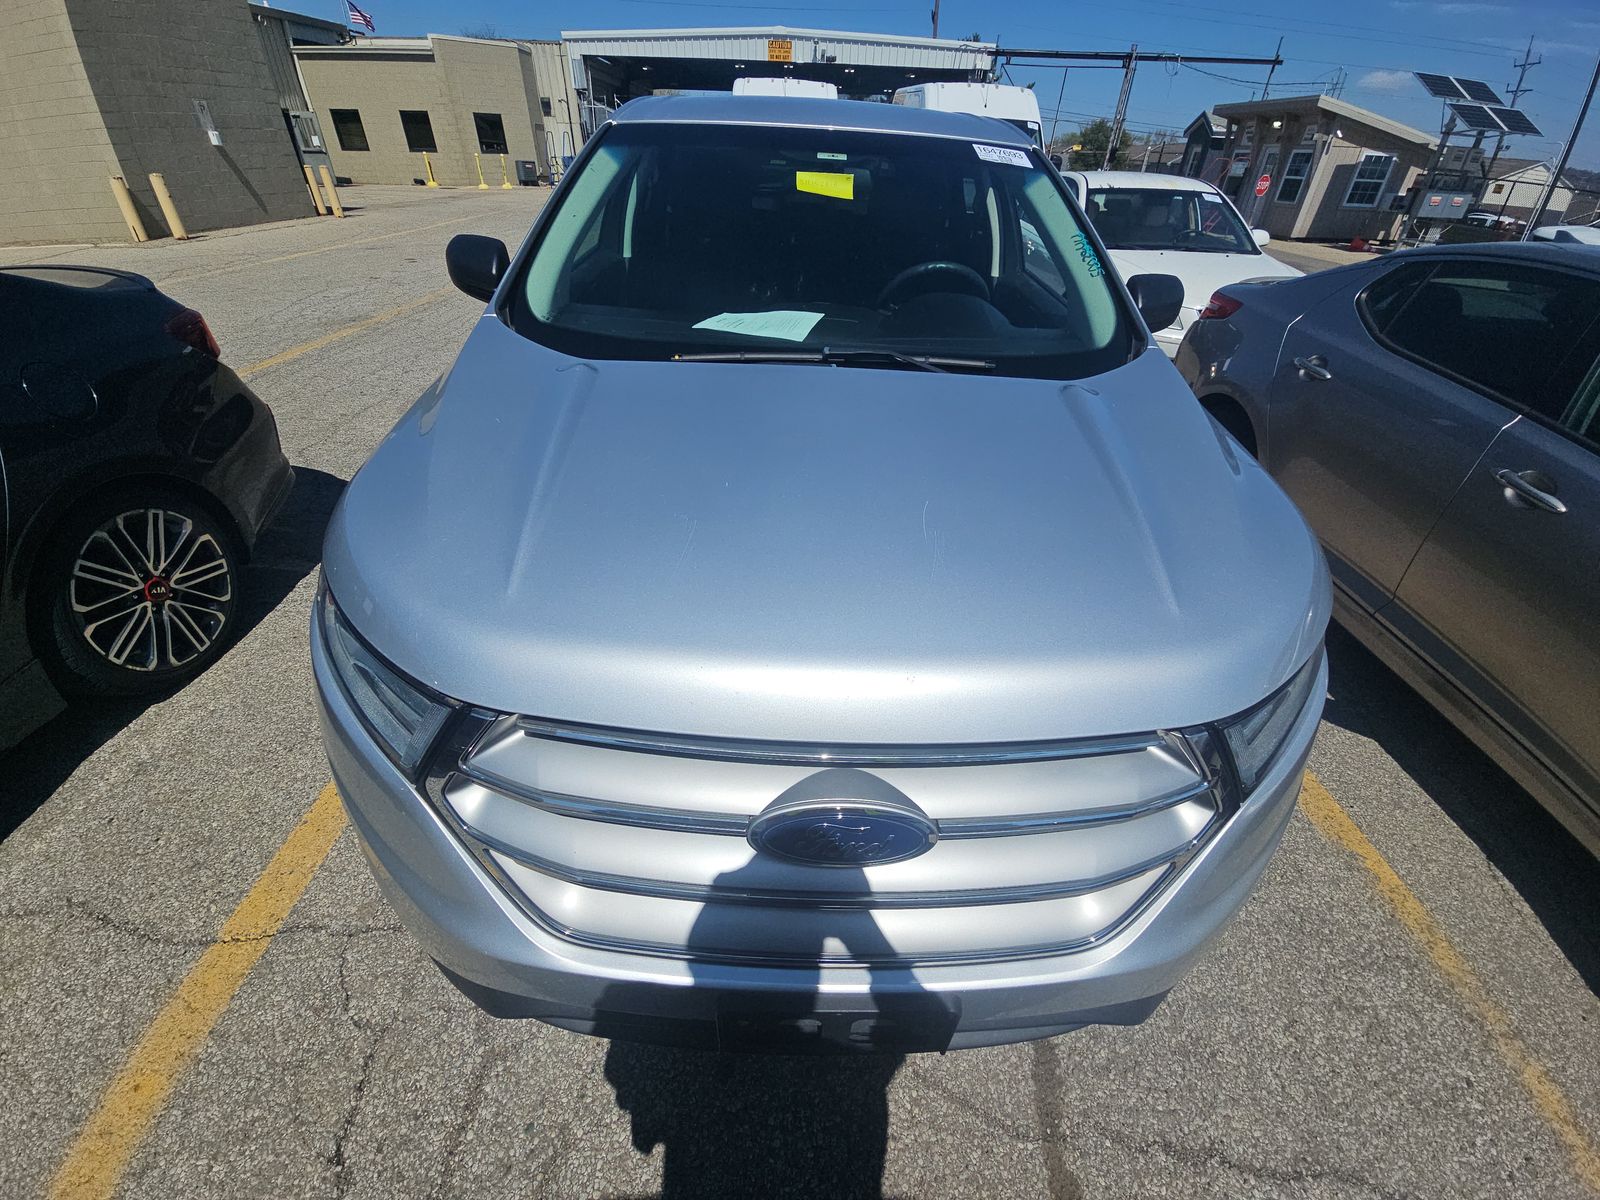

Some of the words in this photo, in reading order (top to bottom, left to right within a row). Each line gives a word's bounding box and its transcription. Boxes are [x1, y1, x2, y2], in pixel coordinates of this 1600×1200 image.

[768, 40, 792, 49] CAUTION
[1256, 181, 1269, 190] STOP
[798, 822, 896, 858] Ford
